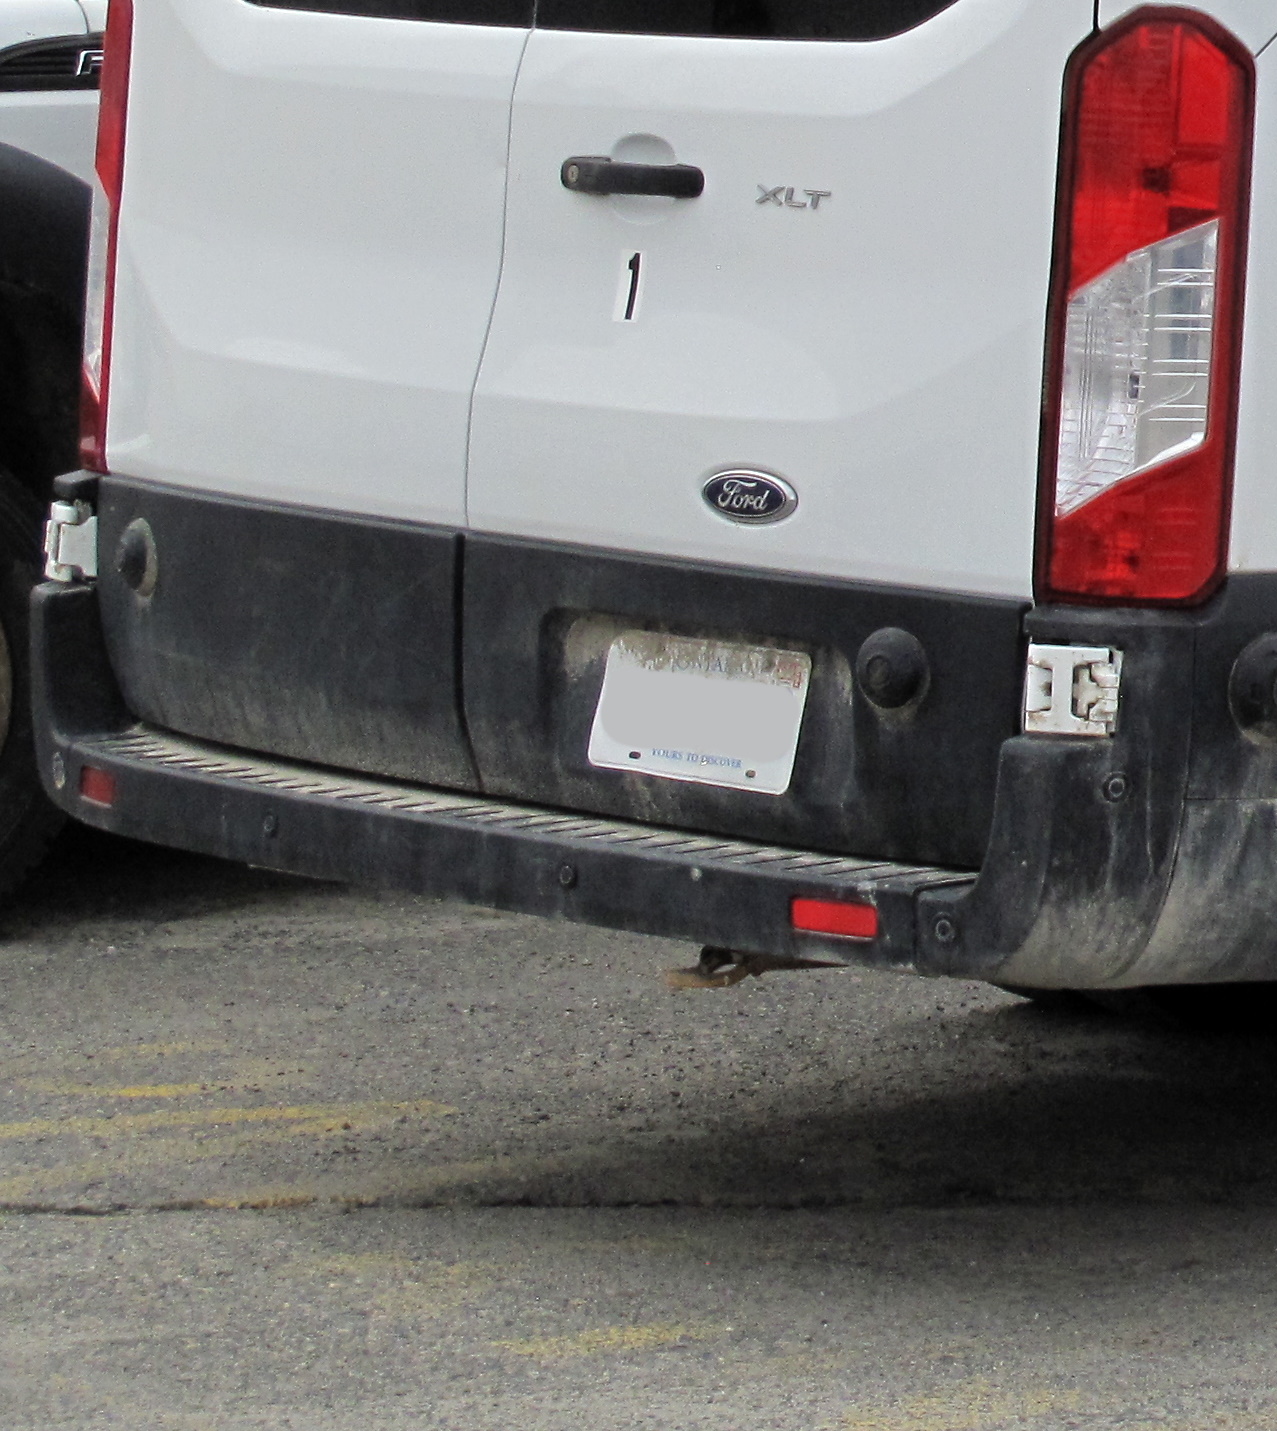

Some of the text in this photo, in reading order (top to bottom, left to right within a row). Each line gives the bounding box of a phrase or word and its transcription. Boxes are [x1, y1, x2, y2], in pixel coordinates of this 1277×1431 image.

[755, 184, 832, 210] XLT
[624, 252, 641, 320] 1
[717, 479, 771, 511] Ford
